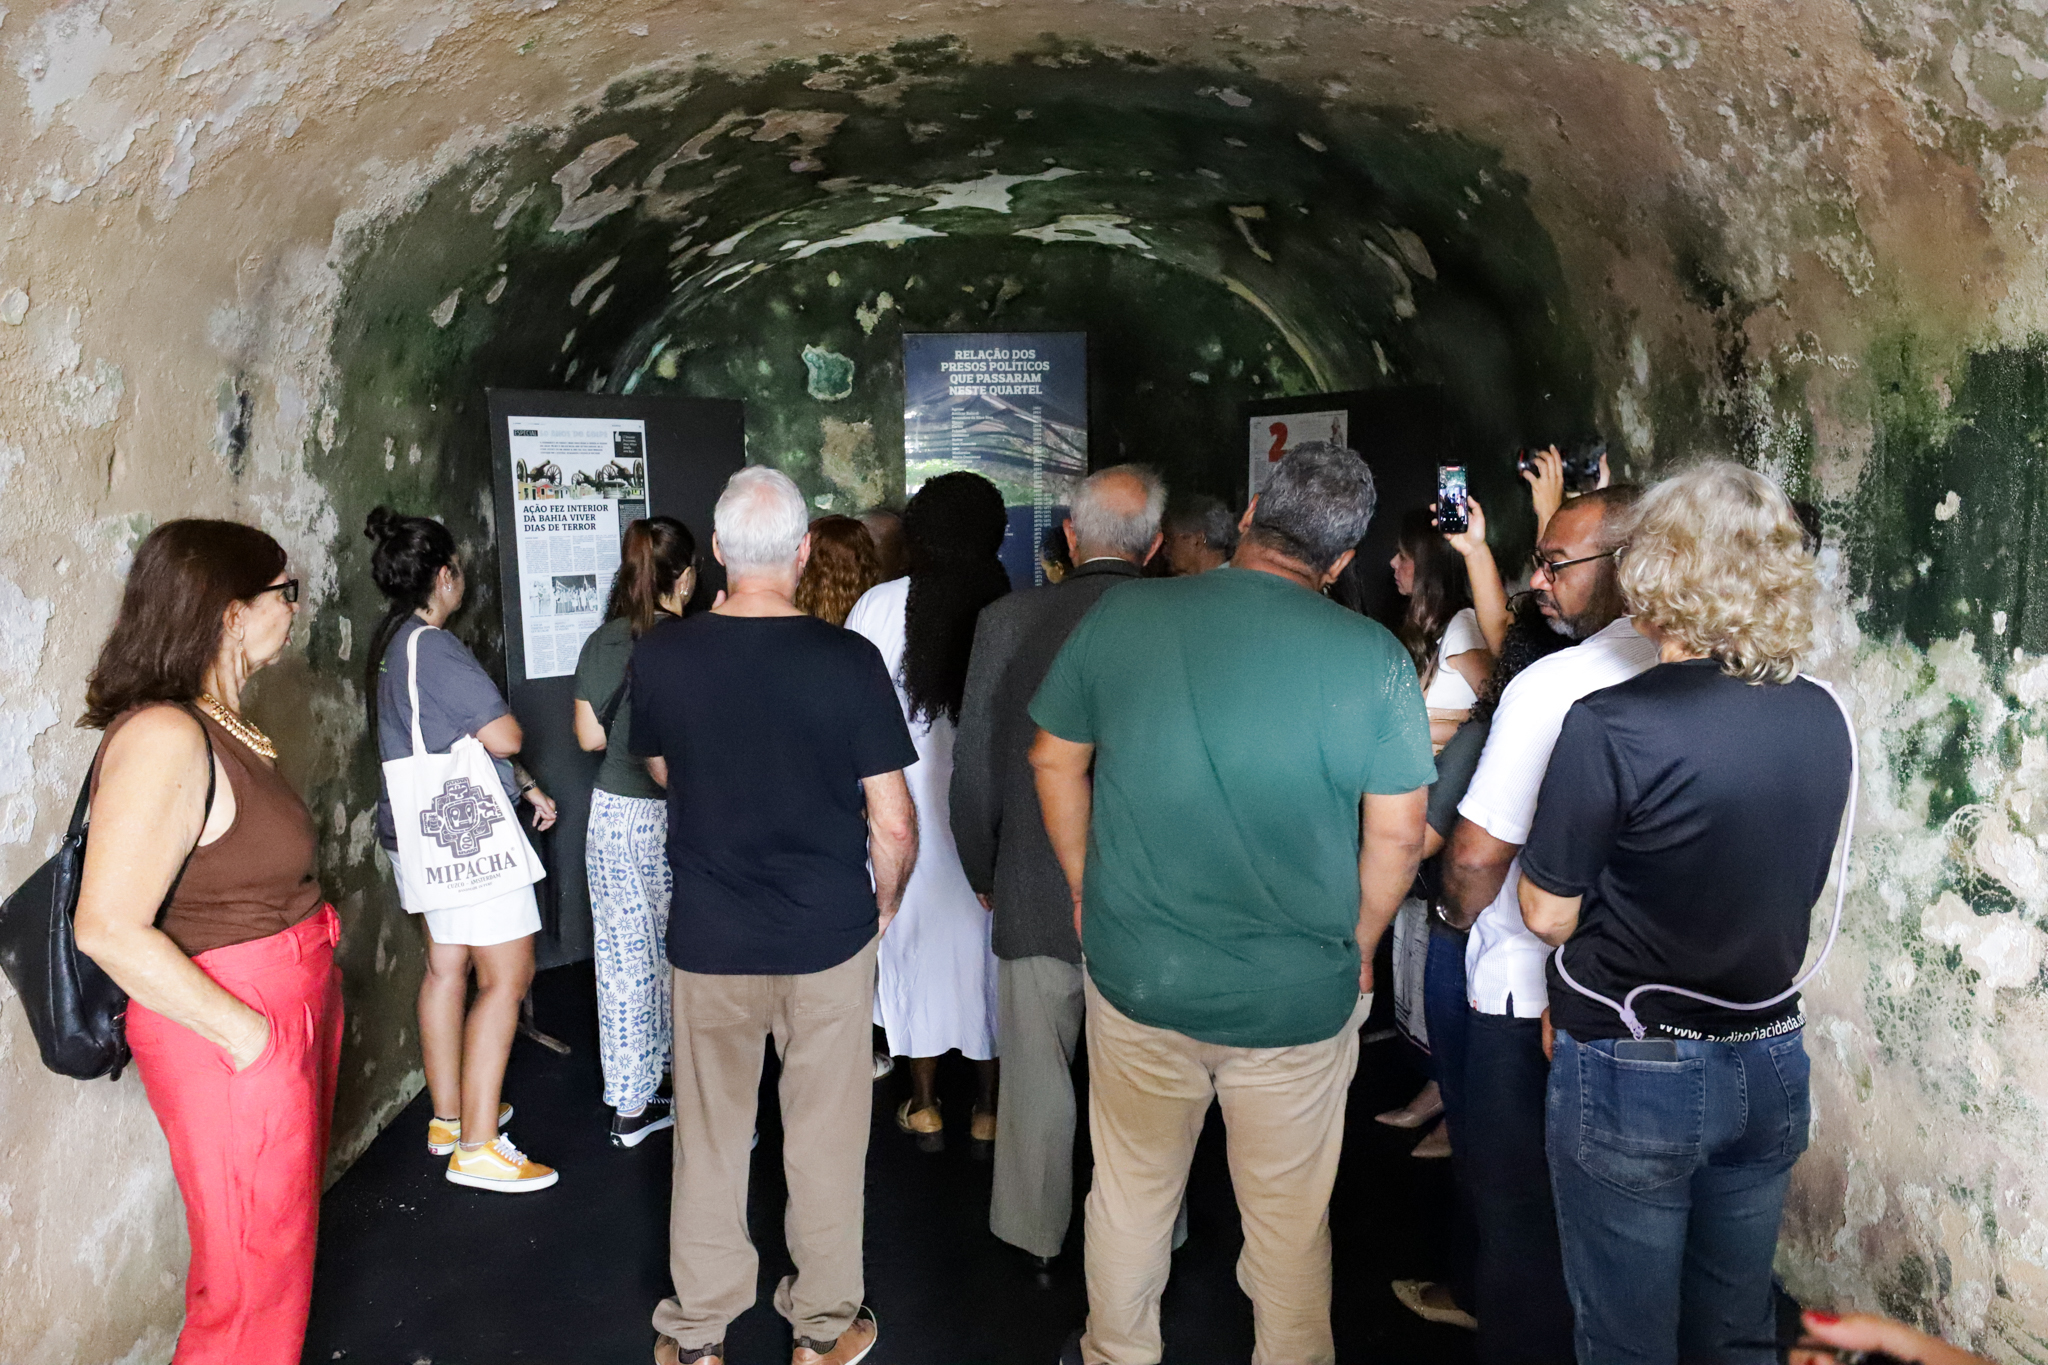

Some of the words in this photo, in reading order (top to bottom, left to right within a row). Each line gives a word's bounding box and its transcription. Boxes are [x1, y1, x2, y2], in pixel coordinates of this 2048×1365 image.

[955, 348, 1010, 361] RELAÇÃO
[1012, 350, 1036, 359] DOS
[941, 362, 987, 372] PRESOS
[989, 359, 1050, 371] POLÍTICOS
[950, 374, 974, 384] QUE
[976, 373, 1042, 383] PASSARAM
[949, 385, 987, 395] NESTE
[989, 385, 1042, 396] QUARTEL
[1268, 422, 1292, 462] 2
[523, 503, 547, 514] AÇÃO
[567, 504, 609, 512] INTERIOR
[539, 514, 567, 522] BAHIA
[524, 524, 546, 532] DIAS
[548, 523, 560, 531] DE
[562, 523, 596, 531] TERROR
[425, 851, 517, 885] MIPACHA
[447, 881, 464, 889] CUZCO
[470, 872, 501, 885] AMSTERDAM
